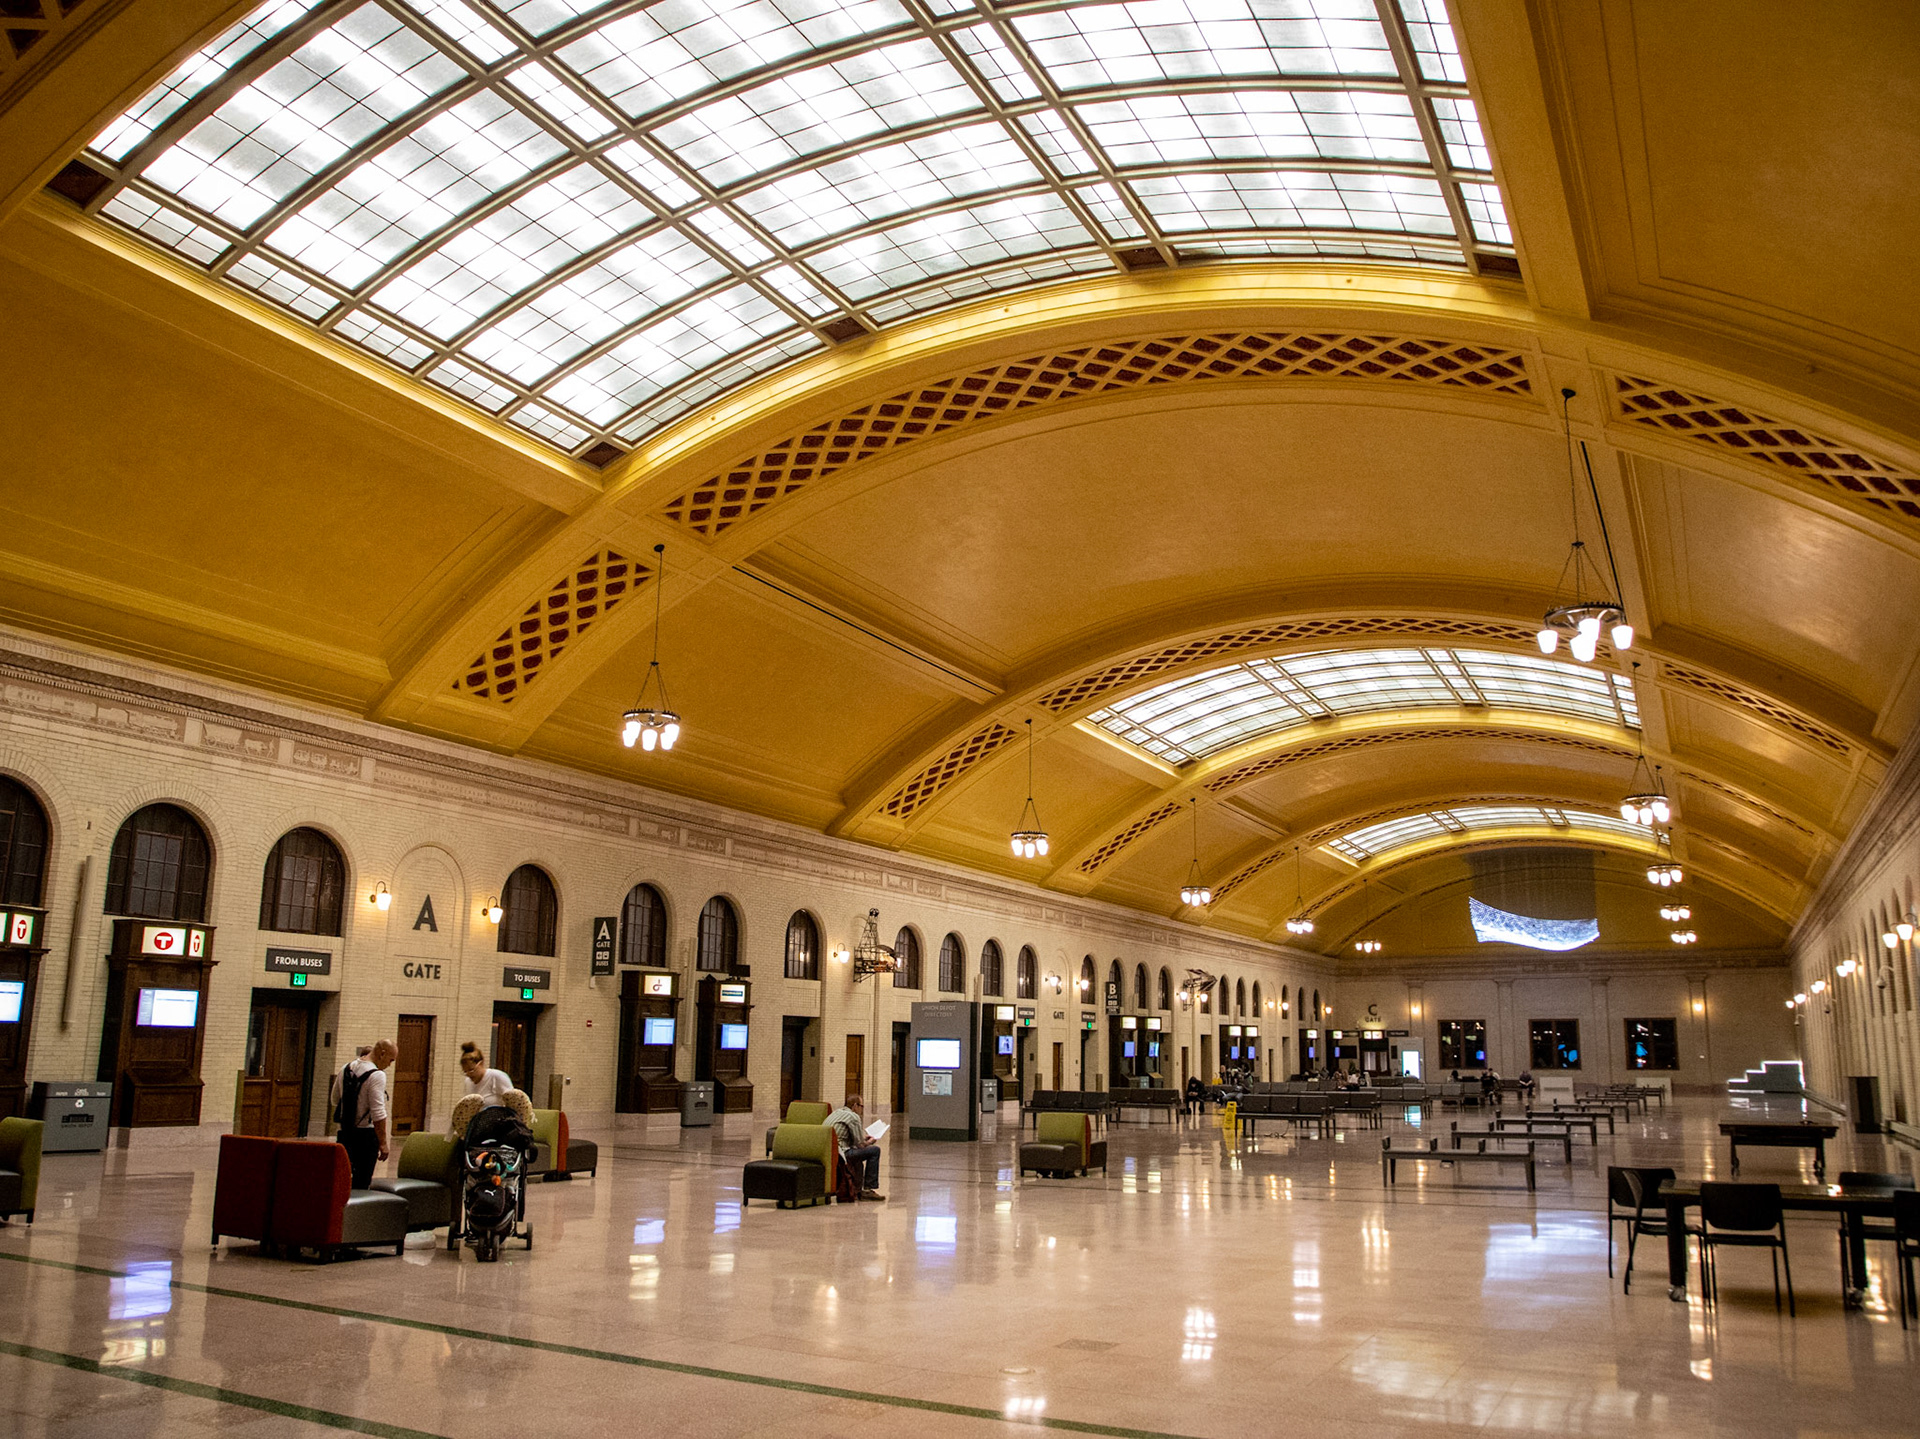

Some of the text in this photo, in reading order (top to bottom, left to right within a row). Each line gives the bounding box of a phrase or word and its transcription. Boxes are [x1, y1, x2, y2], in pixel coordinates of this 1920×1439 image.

[412, 894, 438, 932] A
[598, 921, 610, 939] A
[155, 934, 172, 949] T
[275, 956, 322, 967] FROM BUSES
[403, 963, 441, 979] GATE
[525, 975, 540, 983] BUSES
[1109, 984, 1116, 994] B
[1053, 1011, 1064, 1019] GATE
[1368, 1004, 1377, 1016] C
